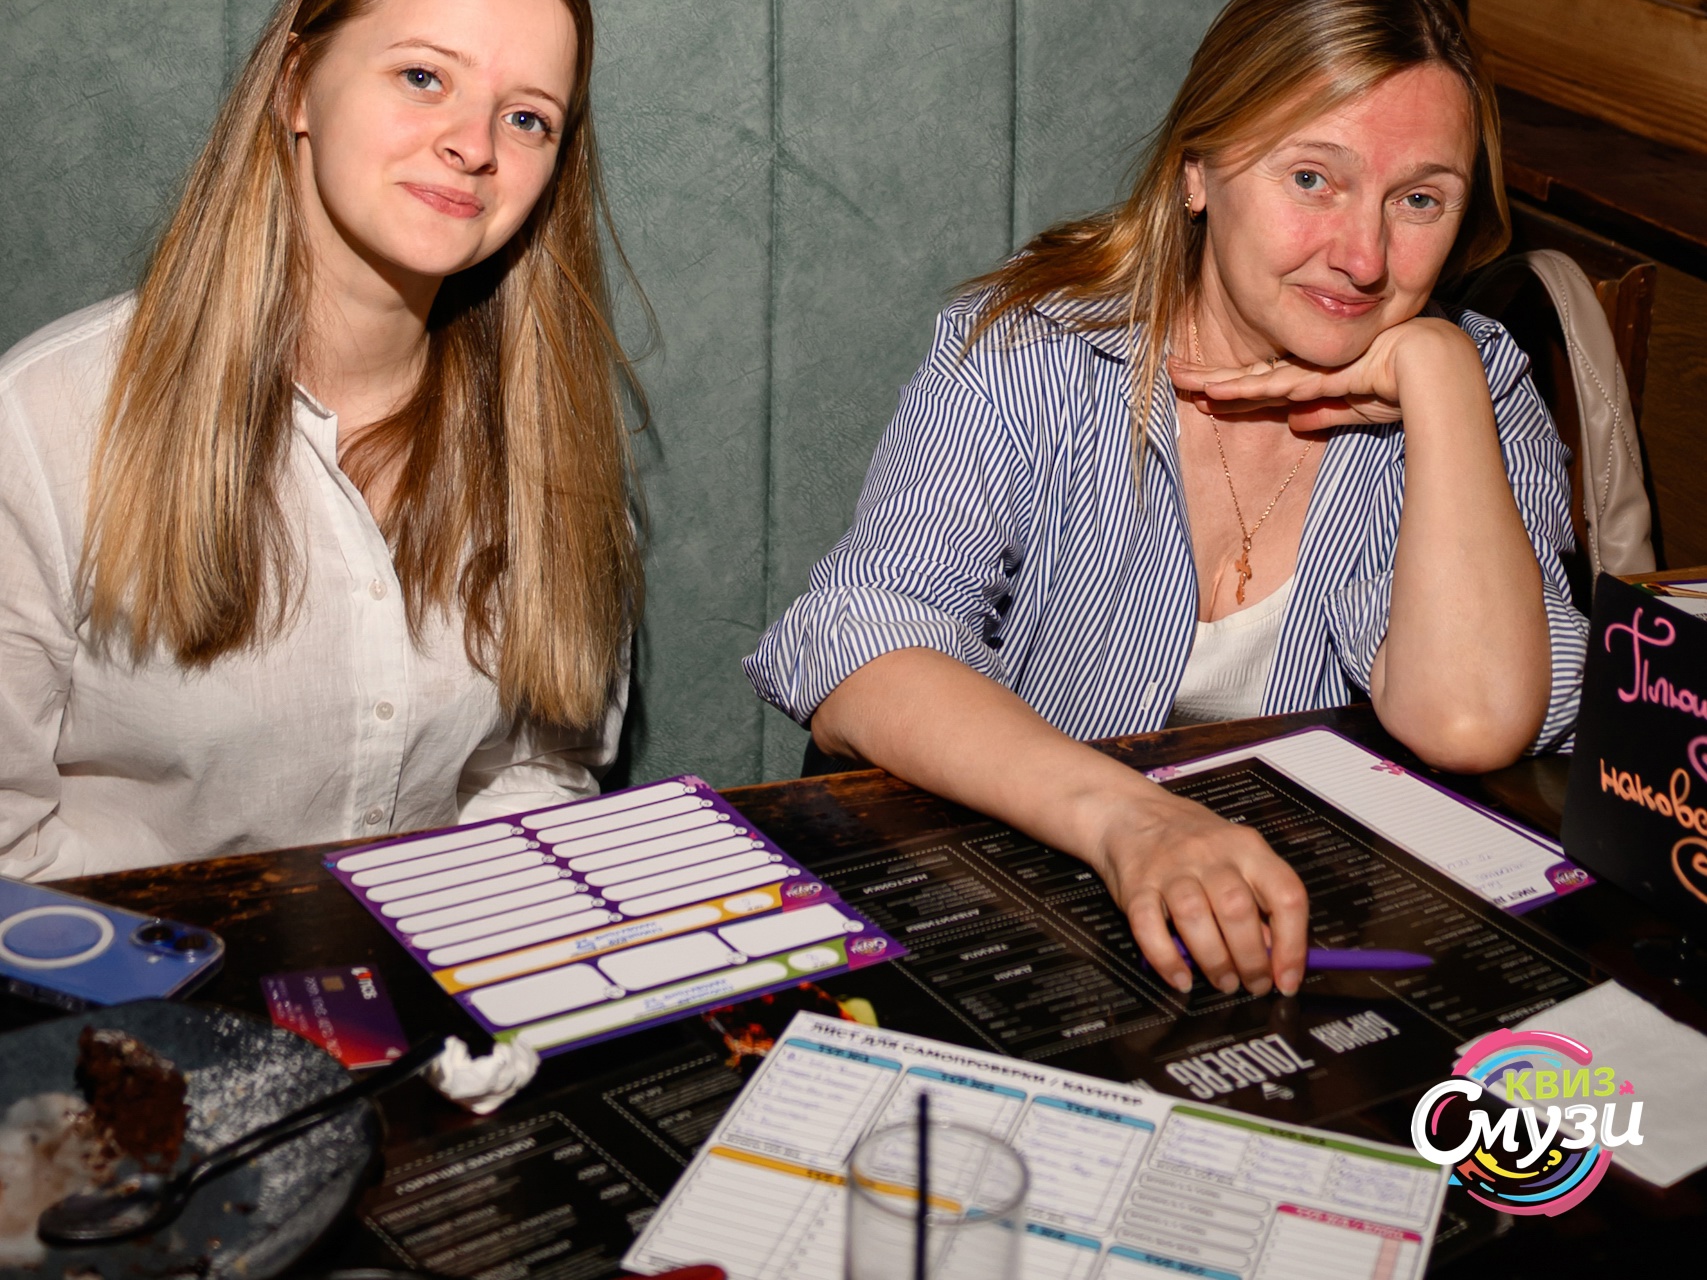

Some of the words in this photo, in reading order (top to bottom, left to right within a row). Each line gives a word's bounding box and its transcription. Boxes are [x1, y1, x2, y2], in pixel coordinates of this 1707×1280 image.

[862, 873, 928, 895] НАСТОЙКИ
[906, 908, 980, 933] АПЕРИТИВЫ
[959, 943, 1009, 961] ТЕКИЛА
[994, 964, 1032, 981] ДЖИН
[1061, 1019, 1107, 1038] ВОДКА
[1309, 1010, 1400, 1053] БАРНАЯ
[811, 1022, 857, 1041] ЛИСТ
[860, 1035, 898, 1052] ДЛЯ
[902, 1041, 1046, 1085] САМОПРОВЕРКИ
[1062, 1079, 1143, 1107] КАУНТЕР
[1166, 1033, 1315, 1099] ZOLBERG
